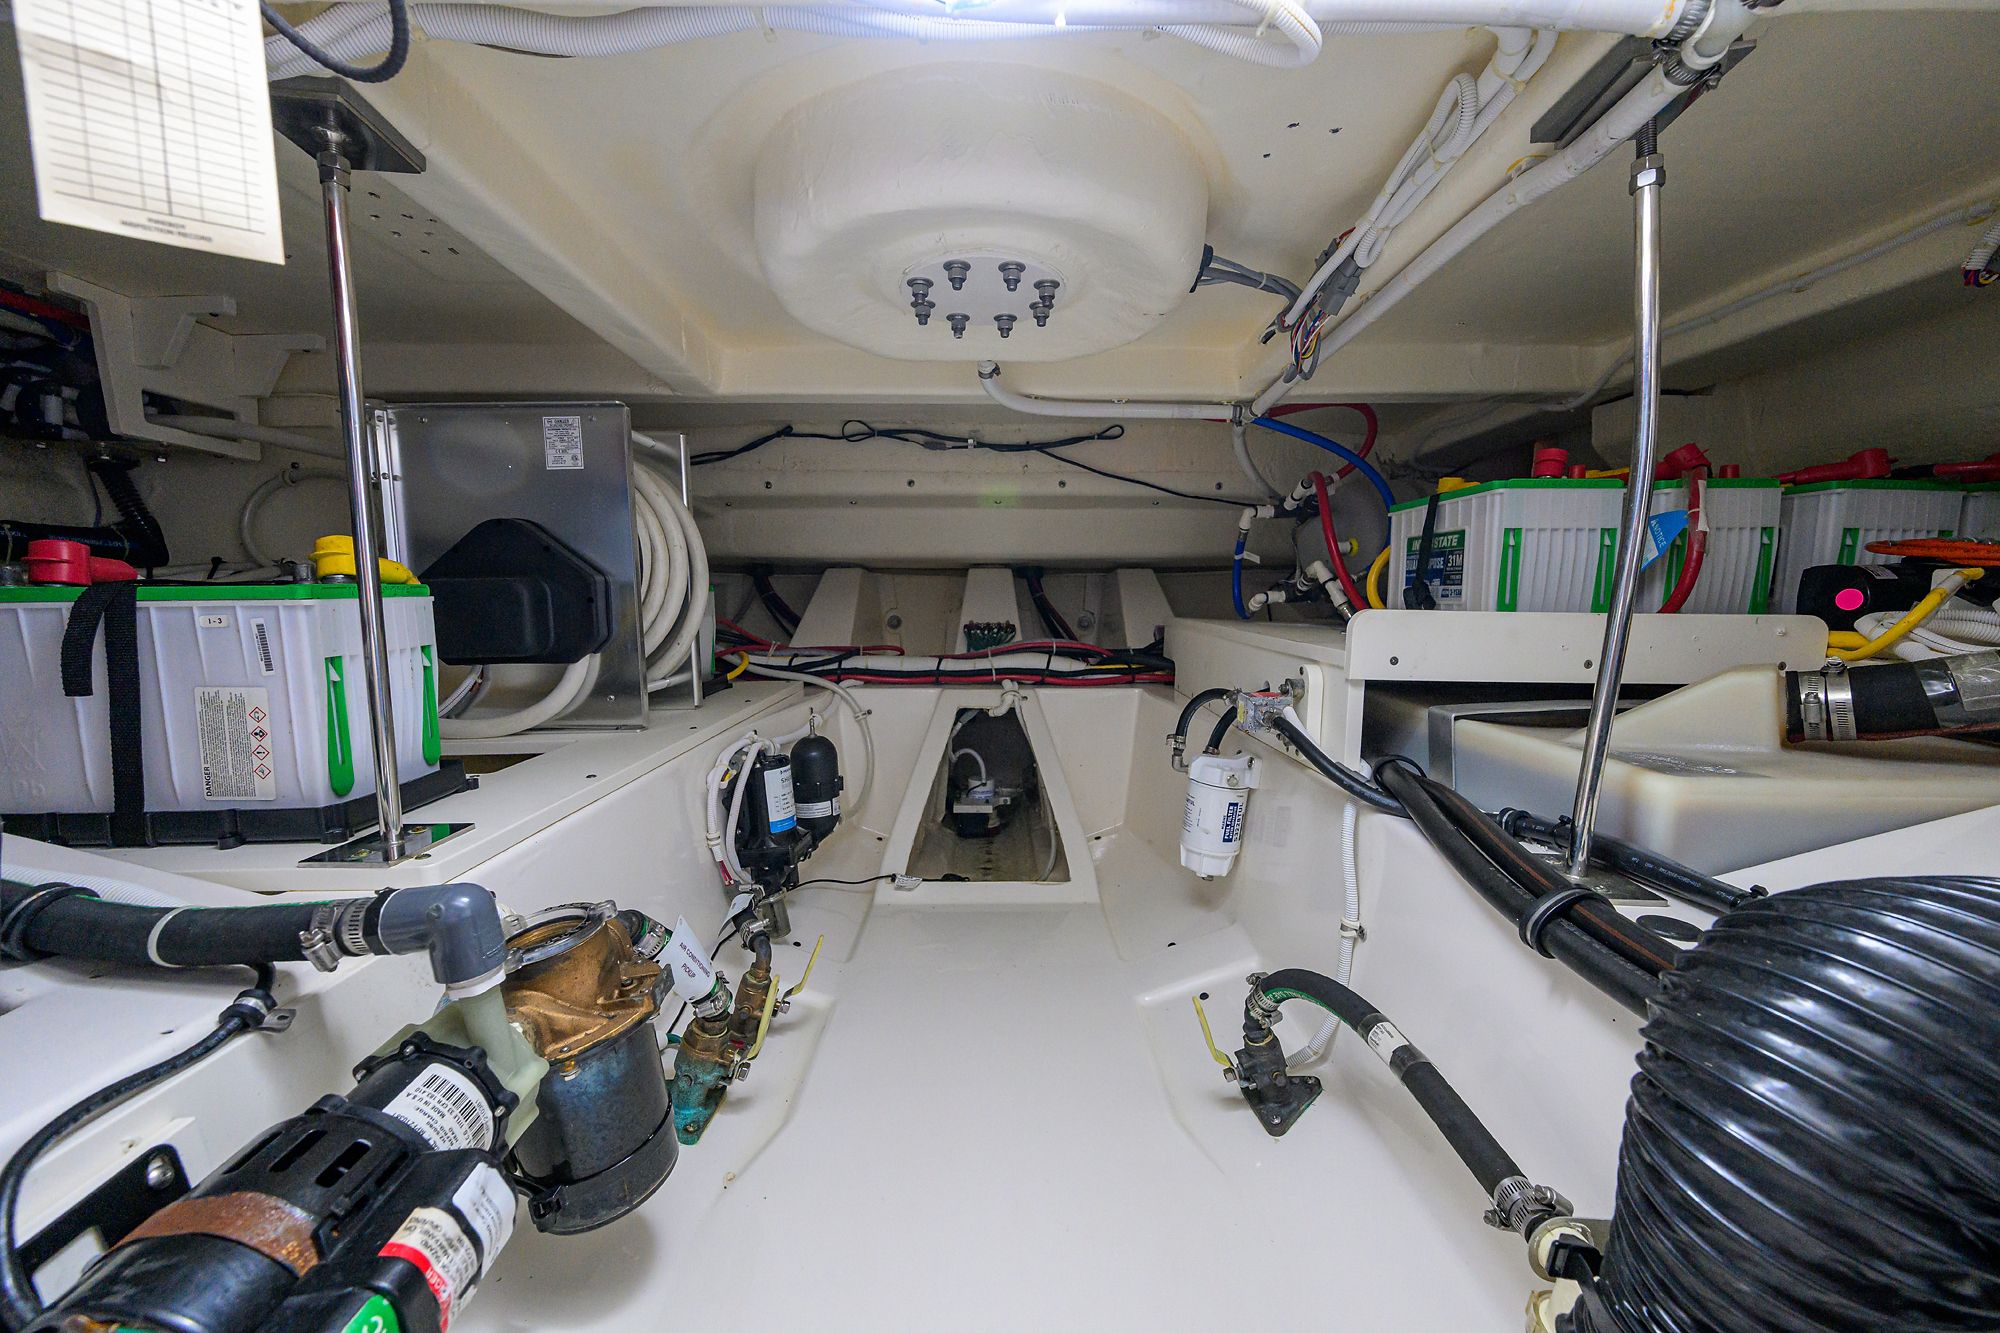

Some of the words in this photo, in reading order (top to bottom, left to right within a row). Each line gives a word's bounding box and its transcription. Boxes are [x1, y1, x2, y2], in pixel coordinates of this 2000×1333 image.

[1411, 534, 1460, 551] INSTATE
[1654, 523, 1667, 548] NOTICE
[1447, 554, 1463, 567] 31M
[205, 766, 213, 797] DANGER
[1226, 805, 1234, 825] FILTER
[679, 942, 688, 952] AIR
[686, 948, 711, 978] CONDITIONING
[681, 963, 697, 978] PICKUP
[422, 1099, 431, 1108] IN
[429, 1104, 446, 1119] MADE
[435, 1097, 449, 1109] CFR
[452, 1112, 465, 1129] TITLE
